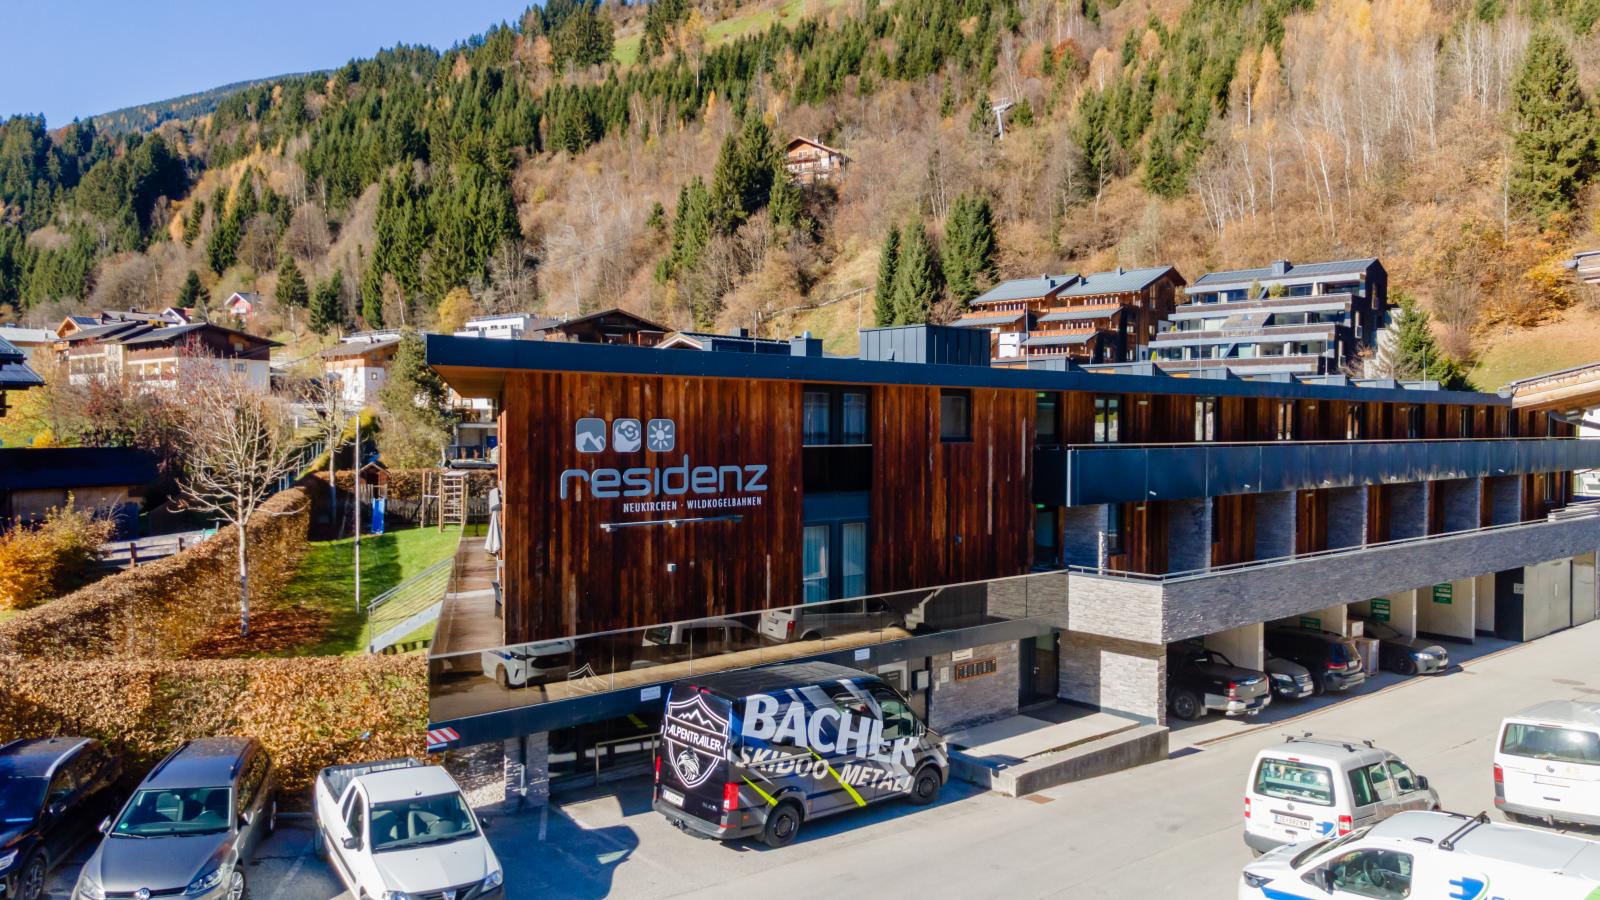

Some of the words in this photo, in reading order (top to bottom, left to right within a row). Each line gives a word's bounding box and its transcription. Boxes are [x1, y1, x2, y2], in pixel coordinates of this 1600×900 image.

[560, 454, 768, 500] residenz
[623, 501, 677, 513] NEUKIRCHEN
[686, 497, 762, 510] WILDKOGELBAHNEN
[668, 724, 721, 752] ALPENTRAILER
[741, 694, 919, 768] BACHER
[736, 747, 830, 780] SKIDOO
